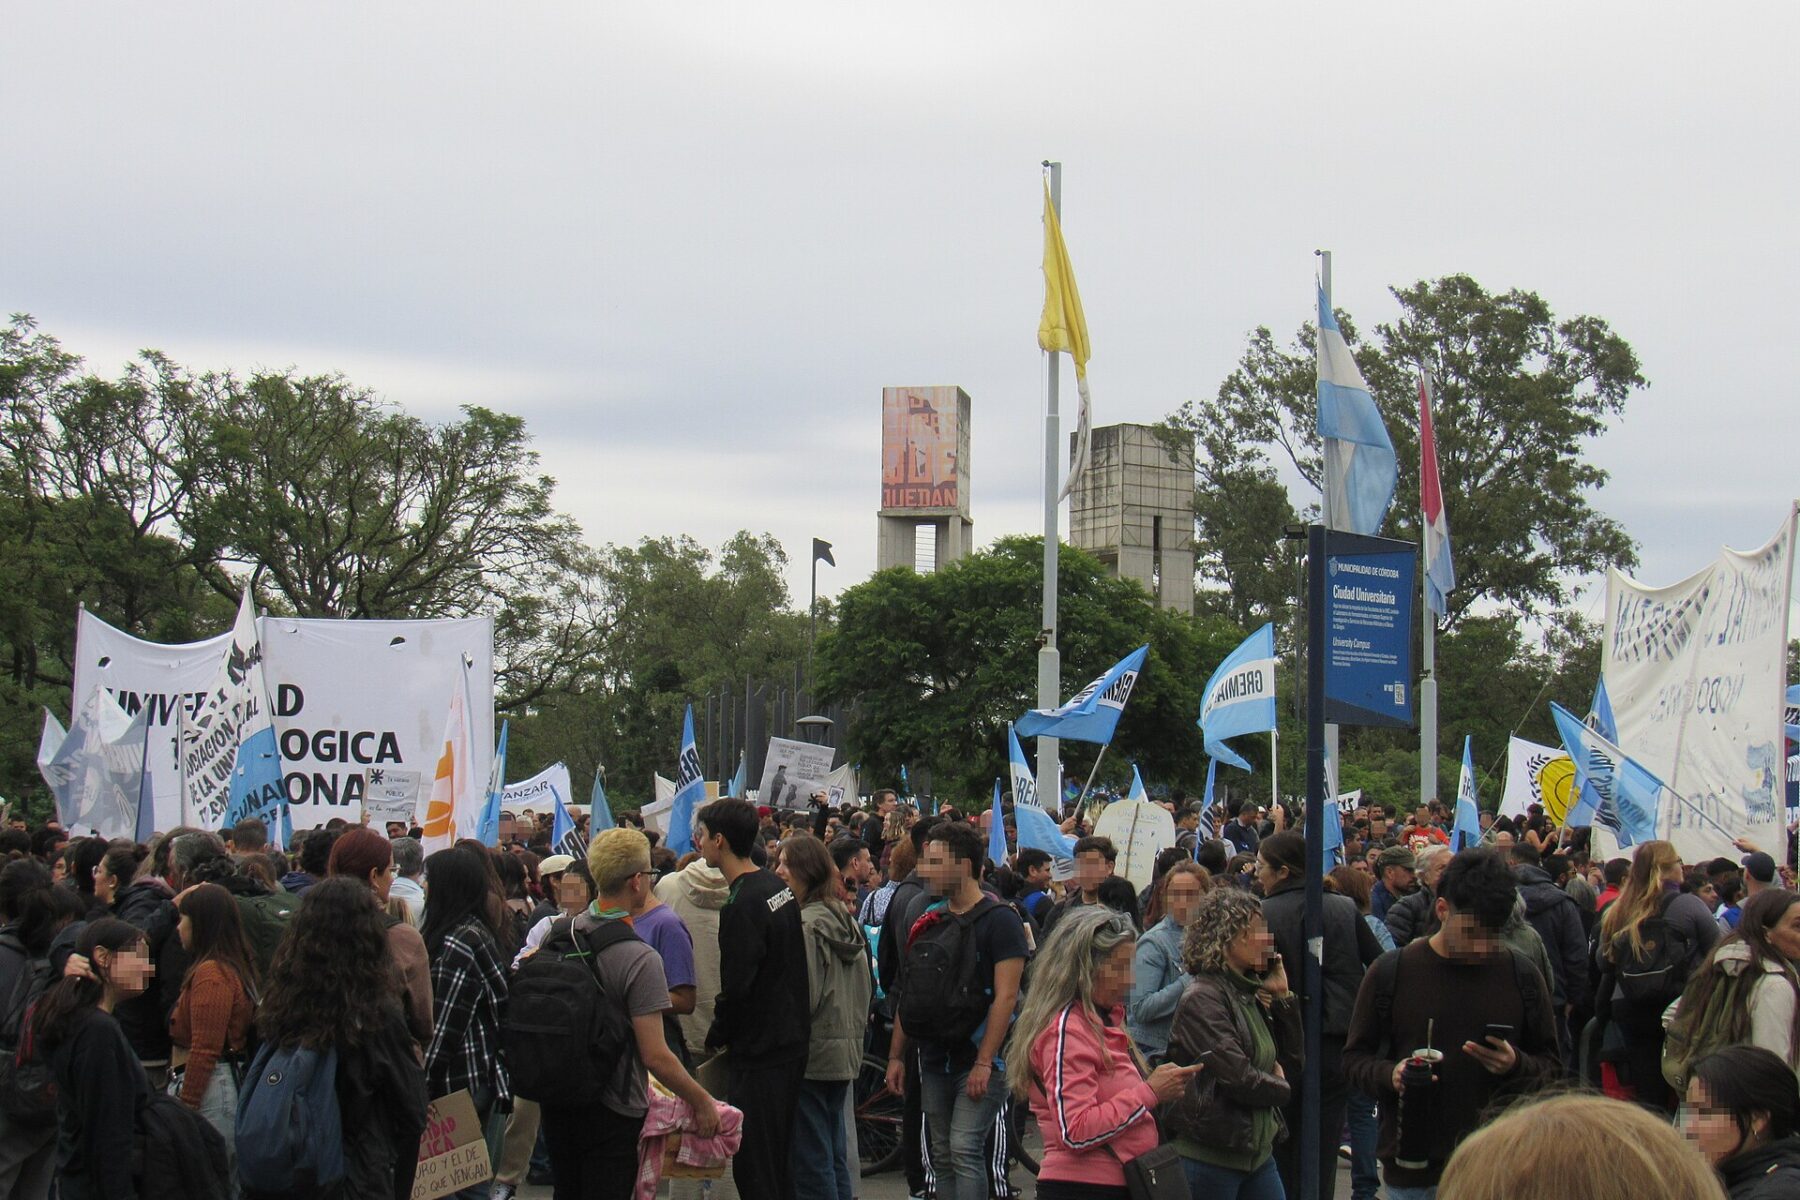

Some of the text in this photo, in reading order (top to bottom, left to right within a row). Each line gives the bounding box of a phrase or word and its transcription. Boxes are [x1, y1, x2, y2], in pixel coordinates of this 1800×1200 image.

[1338, 563, 1399, 578] MUNICIPALIDAD DE CÓRDOBA
[1333, 584, 1395, 605] Ciudad Universitaria
[1332, 636, 1371, 650] University Campus
[503, 780, 549, 800] ANZAR
[451, 1152, 462, 1167] EL
[465, 1146, 480, 1161] DE
[430, 1176, 448, 1192] QUE
[450, 1161, 488, 1186] VENGAN
